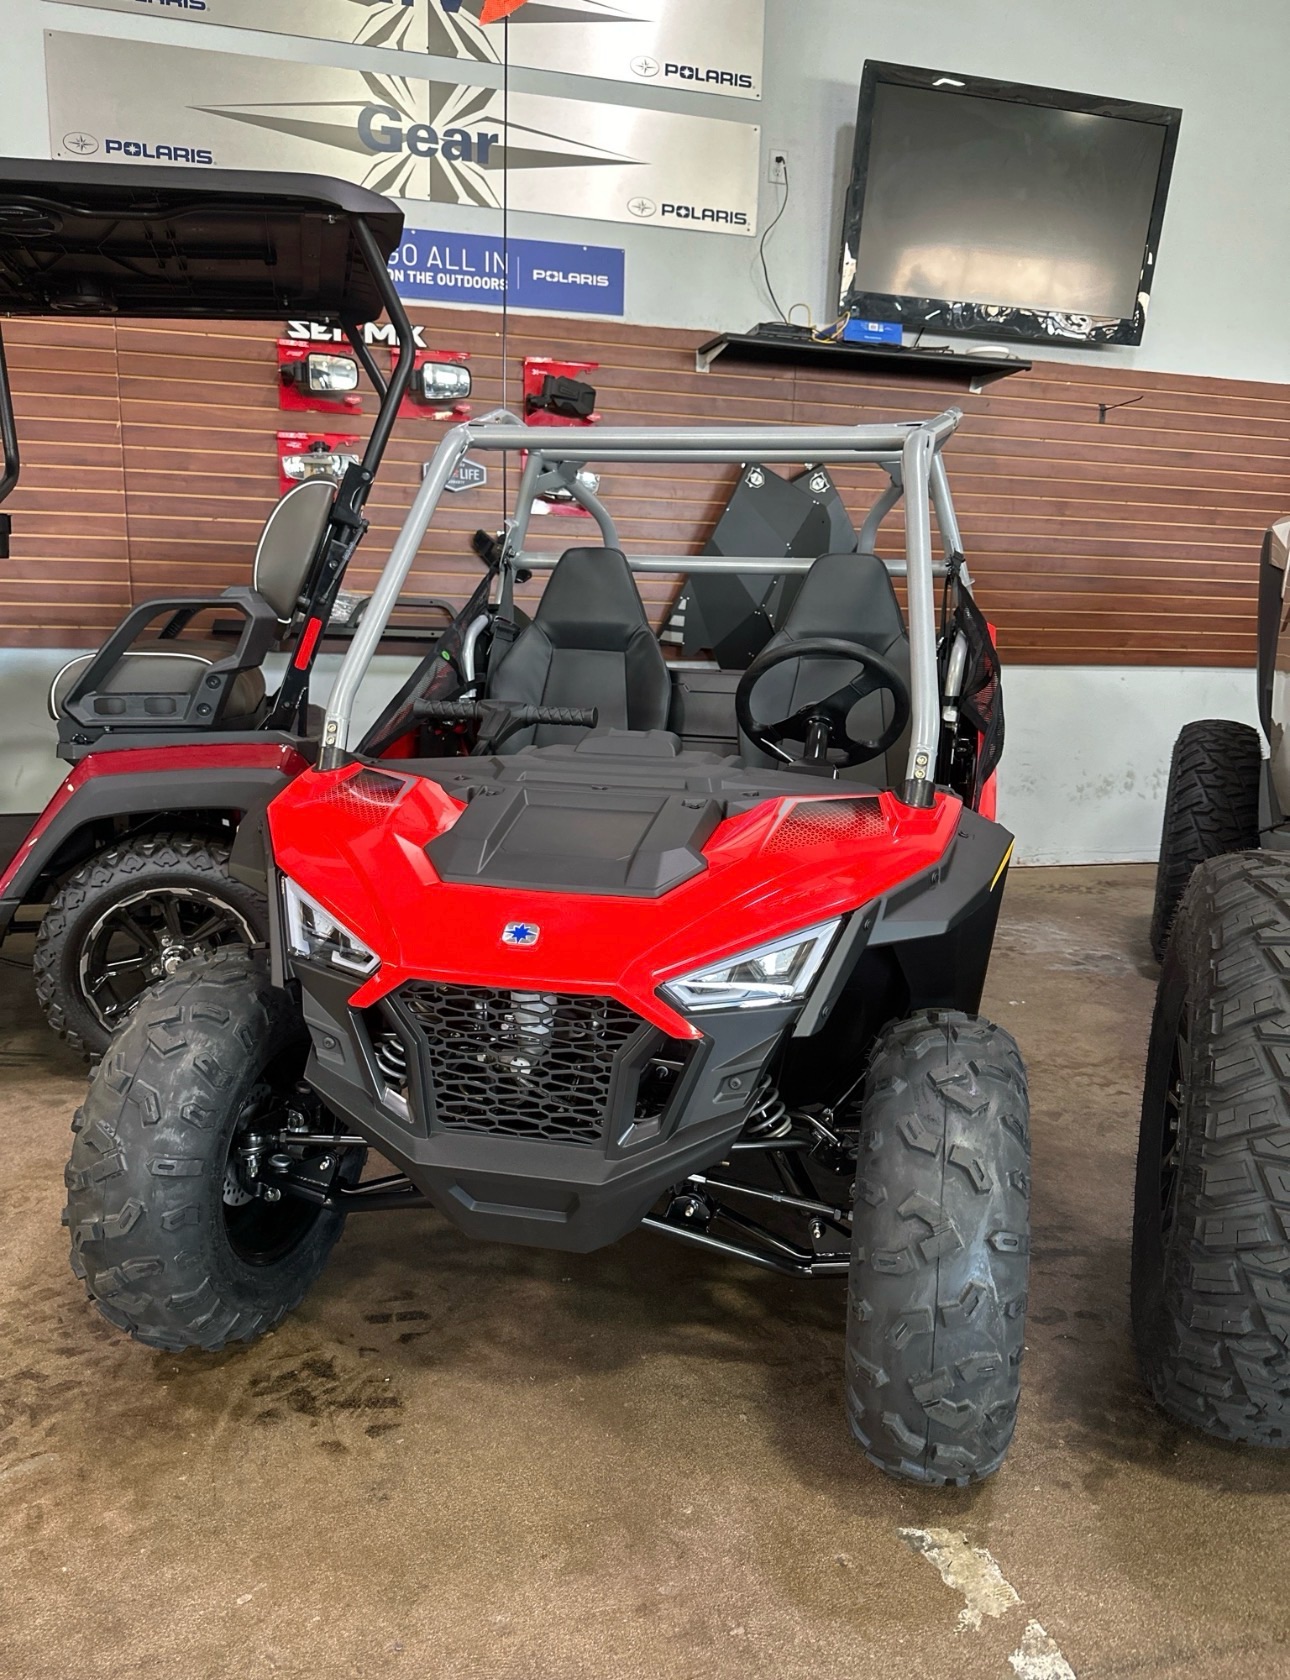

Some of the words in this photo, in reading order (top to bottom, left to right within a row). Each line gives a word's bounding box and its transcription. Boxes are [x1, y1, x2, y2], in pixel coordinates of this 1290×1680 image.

[664, 63, 752, 88] POLARIS
[357, 105, 499, 164] Gear
[105, 139, 213, 165] POLARIS
[661, 203, 747, 225] POLARIS
[427, 246, 476, 271] ALL
[485, 250, 508, 274] IN
[407, 270, 434, 285] THE
[437, 273, 508, 290] OUTDOORS
[533, 269, 609, 286] POLARIS
[460, 468, 480, 480] LIFE
